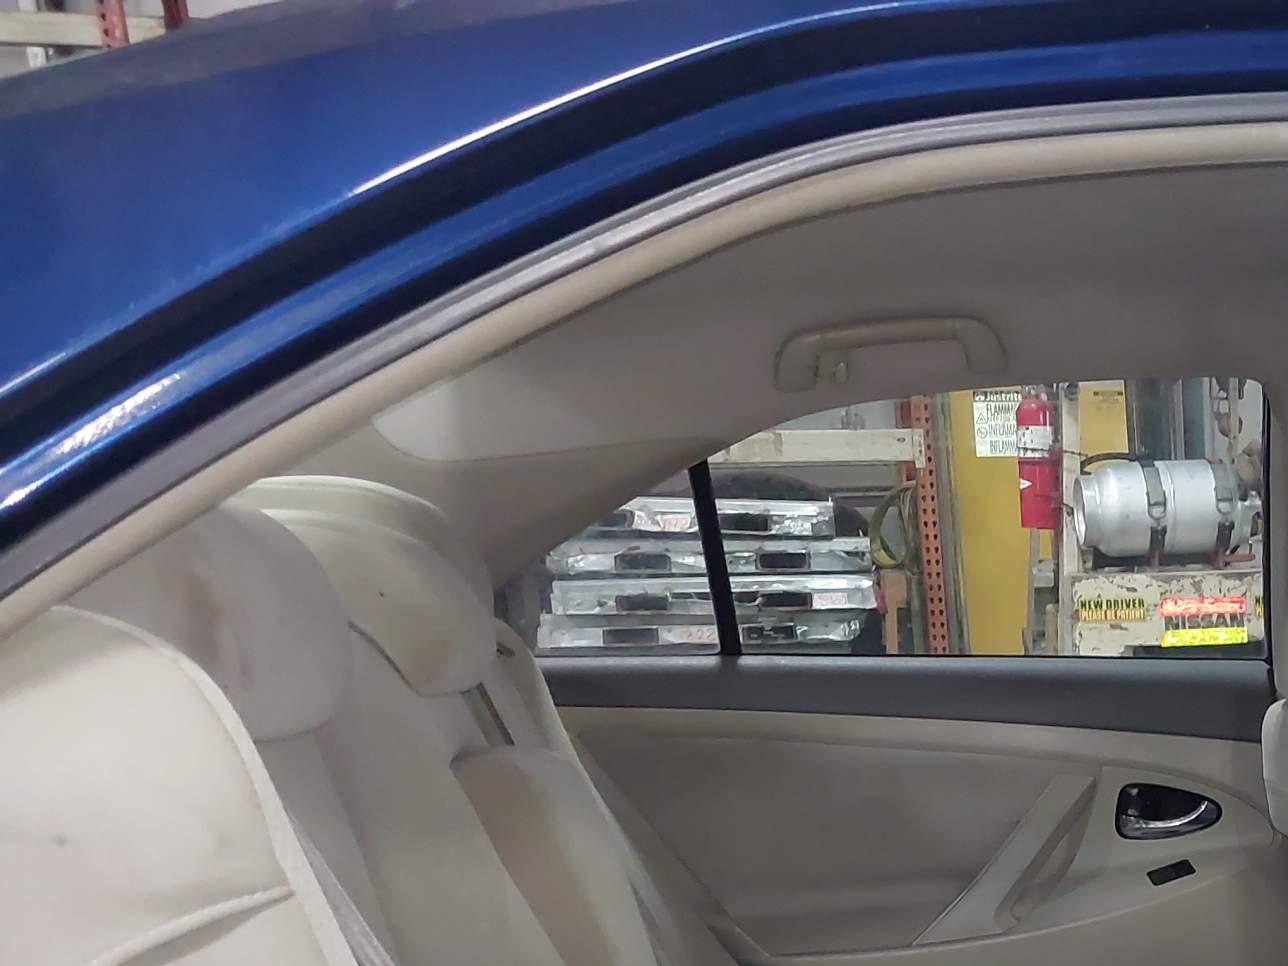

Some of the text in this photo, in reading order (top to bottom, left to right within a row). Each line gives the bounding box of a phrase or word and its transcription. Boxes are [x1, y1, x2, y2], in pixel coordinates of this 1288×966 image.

[986, 404, 1017, 415] FLAMMA
[1080, 598, 1145, 609] NEW DRIVER
[1081, 608, 1145, 621] PLEASE BE PATIENT
[1164, 613, 1245, 631] NISSAN
